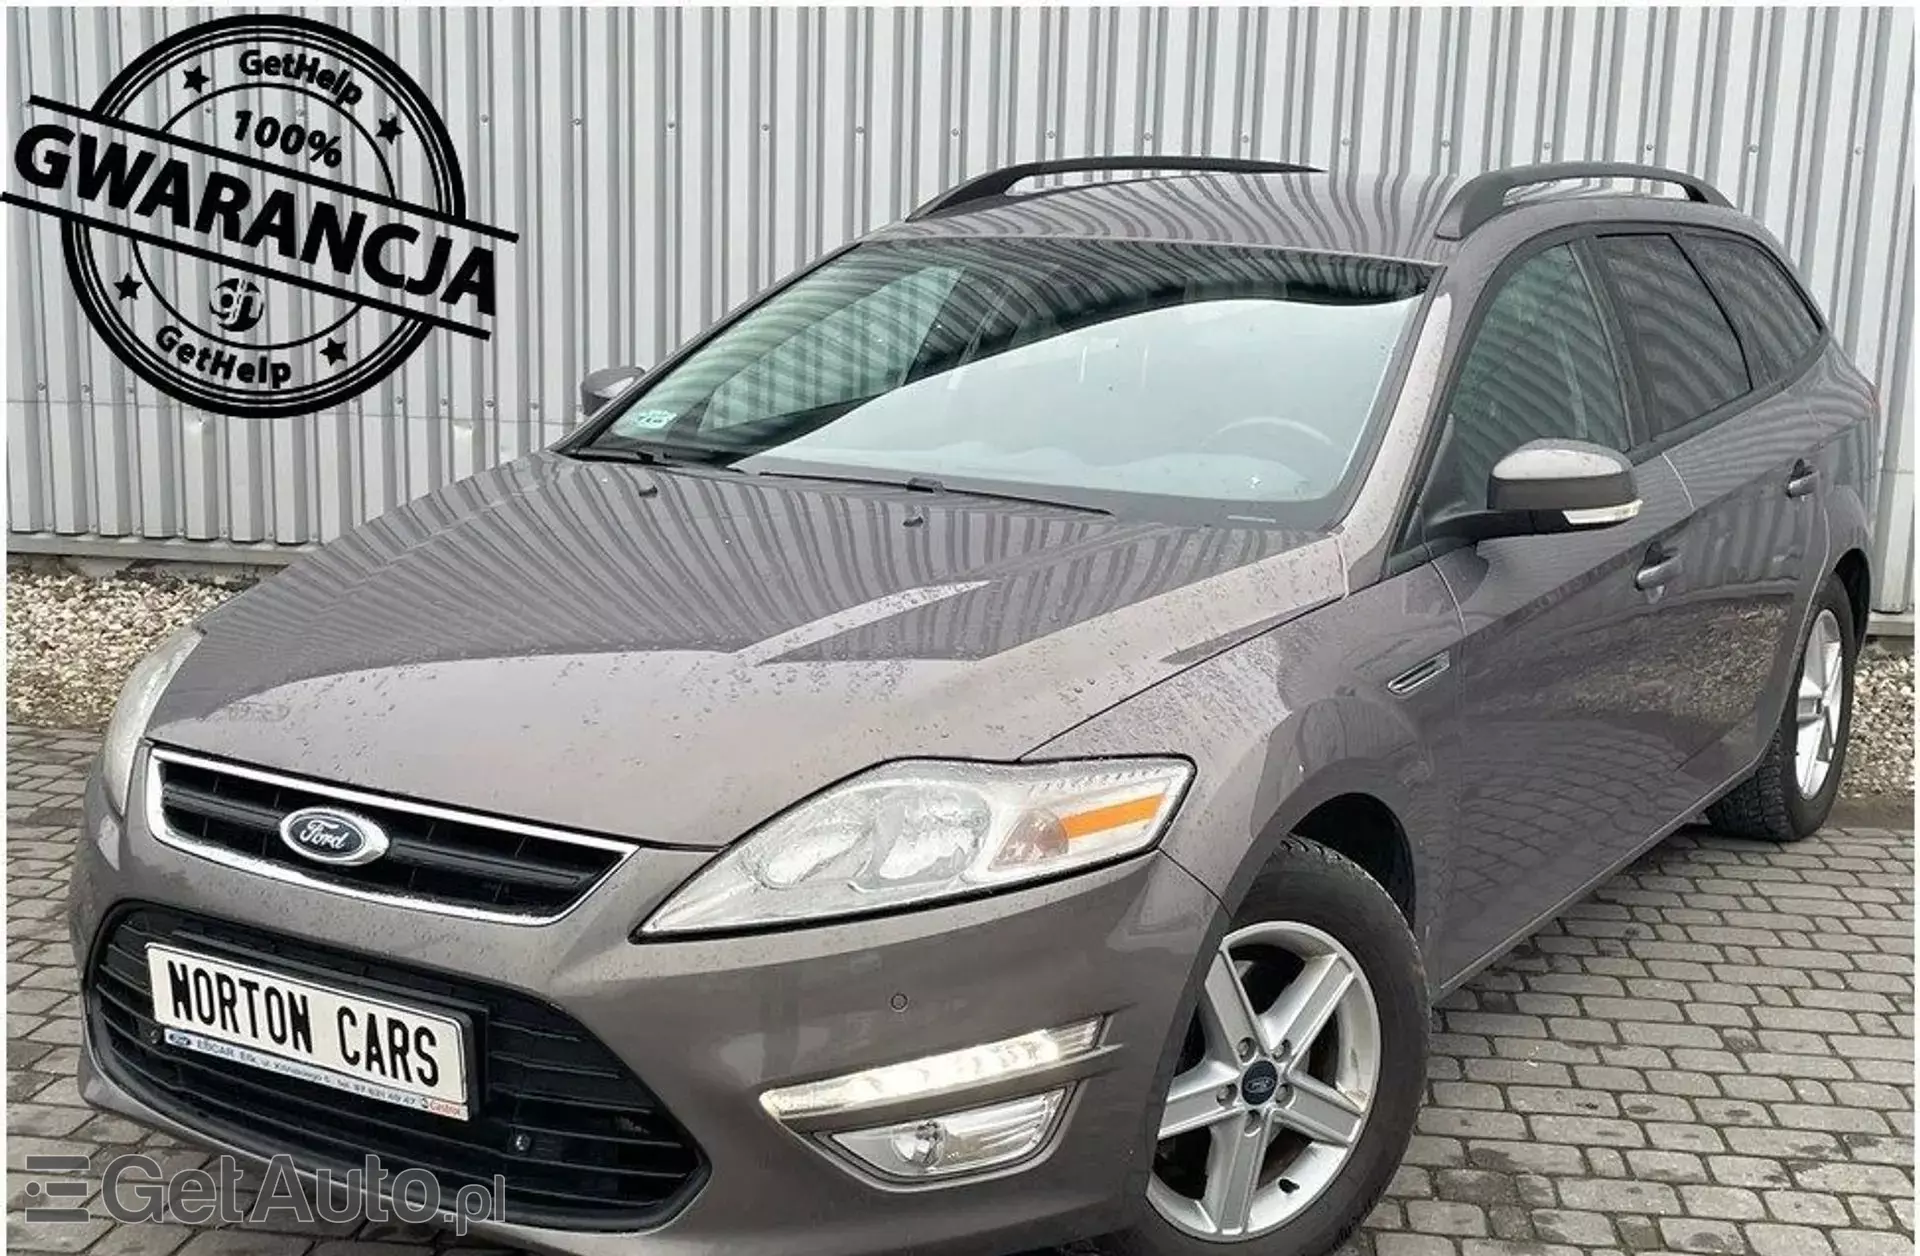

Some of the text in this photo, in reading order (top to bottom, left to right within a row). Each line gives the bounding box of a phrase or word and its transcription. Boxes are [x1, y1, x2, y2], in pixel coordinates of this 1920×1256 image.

[299, 819, 350, 849] Ford
[168, 960, 440, 1089] NORTON CARS
